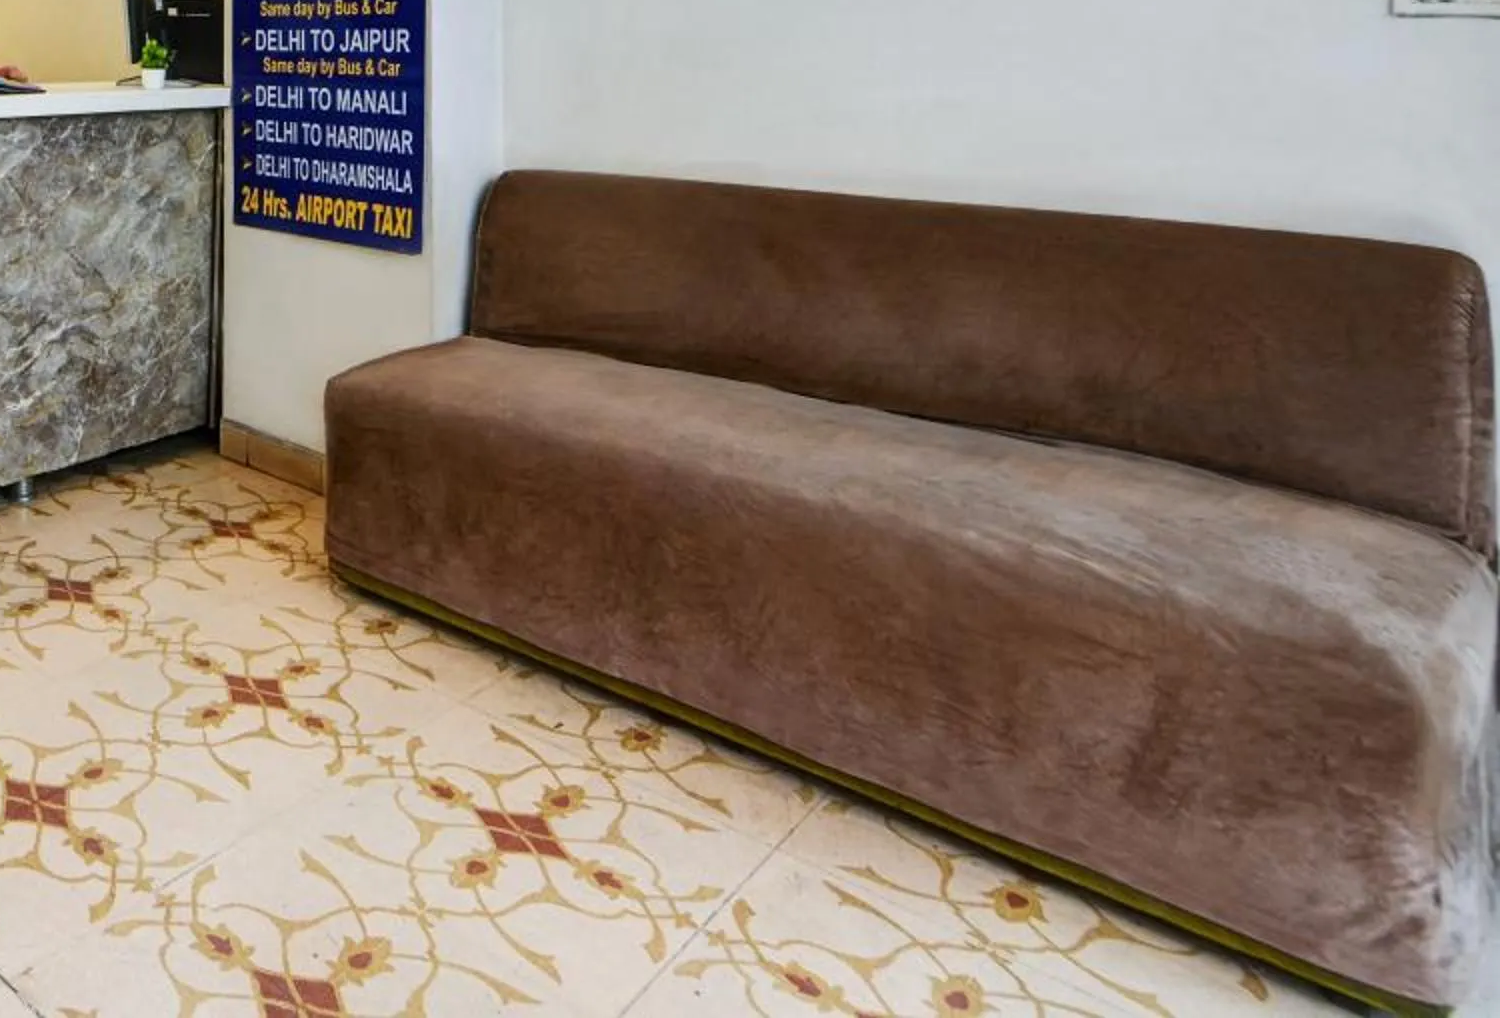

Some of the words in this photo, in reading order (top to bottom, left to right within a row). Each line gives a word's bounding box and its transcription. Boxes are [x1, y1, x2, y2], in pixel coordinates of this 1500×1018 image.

[260, 0, 290, 18] Same
[293, 0, 314, 20] day
[317, 0, 331, 19] by
[255, 29, 304, 52] DELHI
[310, 29, 335, 52] TO
[340, 28, 411, 53] JAIPUR
[263, 57, 293, 74] Same
[297, 57, 317, 78] day
[321, 58, 335, 78] by
[338, 59, 362, 76] Bus
[366, 59, 375, 76] &
[378, 59, 401, 77] Car
[255, 86, 303, 109] DELHI
[308, 87, 331, 111] TO
[337, 89, 407, 115] MANALI
[255, 119, 298, 144] DELHI
[302, 122, 321, 146] TO
[326, 125, 413, 155] HARIDWAR
[255, 154, 291, 179] DELHI
[293, 157, 310, 182] TO
[312, 159, 412, 194] DHARAMSHALA
[241, 186, 259, 213] 24
[263, 189, 292, 219] Hrs.
[296, 193, 368, 231] AIRPORT
[372, 203, 413, 239] TAXI
